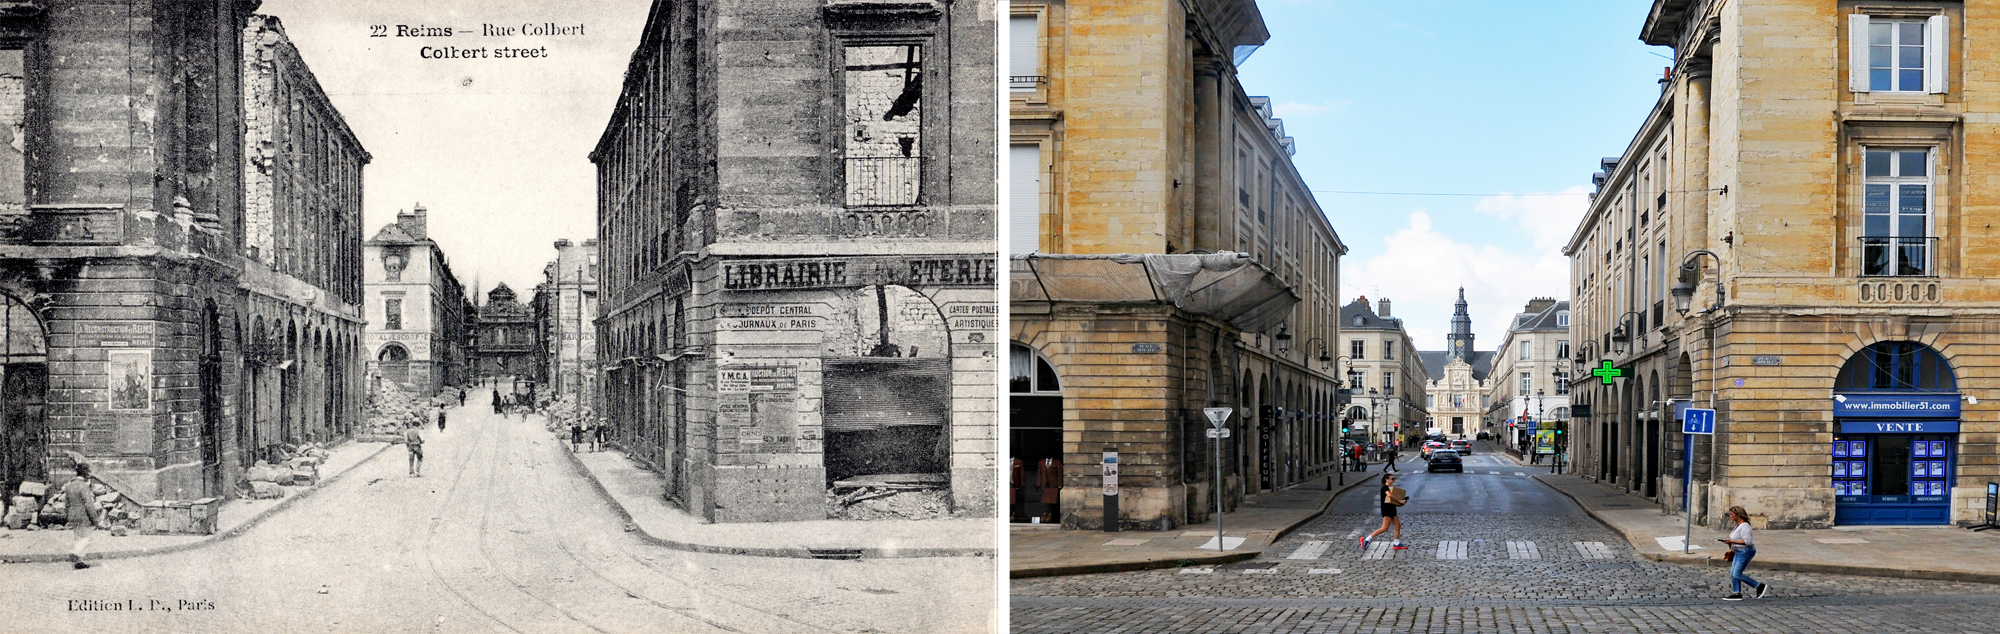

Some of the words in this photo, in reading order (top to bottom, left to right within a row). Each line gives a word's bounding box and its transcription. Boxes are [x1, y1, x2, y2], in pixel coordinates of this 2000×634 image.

[724, 259, 847, 289] LIBRAIRIE
[780, 306, 812, 315] CENTRAL
[949, 306, 969, 314] CARTES
[972, 306, 999, 314] POSTALES
[132, 323, 153, 334] REIMS
[791, 320, 816, 328] PARIS
[954, 320, 999, 329] ARTISTIQUES
[776, 367, 797, 377] REIMS
[1845, 401, 1951, 410] www.immobilier51.com
[1876, 423, 1924, 432] VENTE
